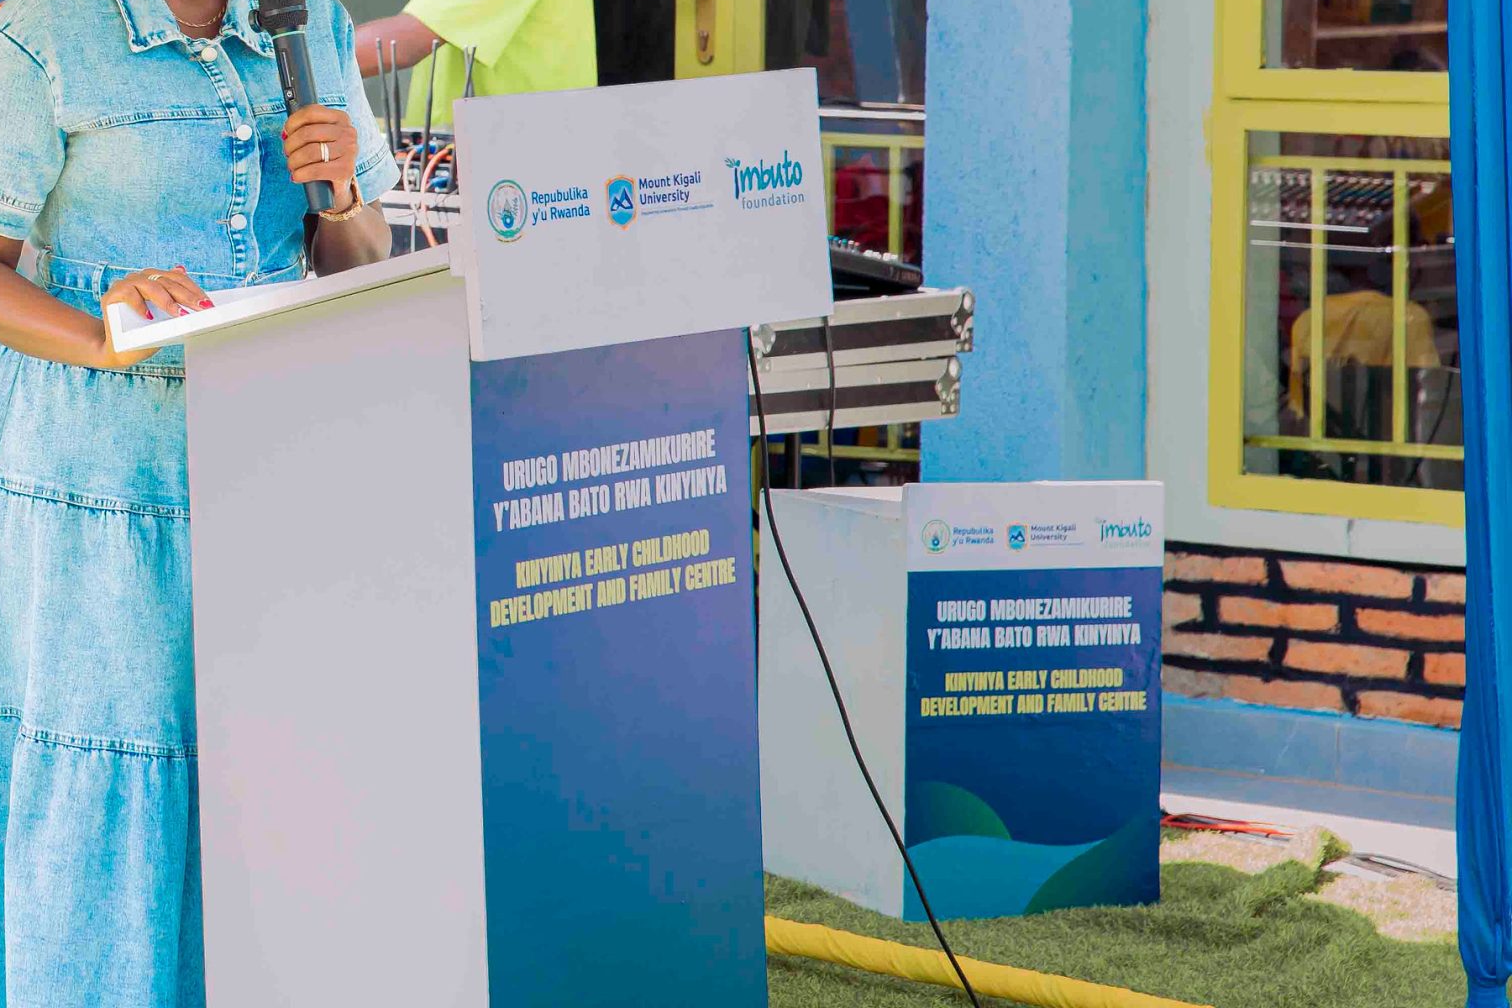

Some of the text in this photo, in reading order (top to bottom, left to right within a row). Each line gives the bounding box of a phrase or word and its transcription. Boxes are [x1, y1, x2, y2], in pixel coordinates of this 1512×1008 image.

[639, 171, 701, 190] Mount Kigali
[735, 150, 802, 200] imbuto
[532, 187, 588, 206] Repubulika
[640, 190, 689, 205] University
[742, 192, 804, 209] foundation
[532, 204, 590, 225] y'u Rwanda
[504, 428, 716, 492] URUGO MBONEZAMIKURIRE
[494, 465, 727, 532] Y'ABANA BATO RWA KINYINYA
[516, 528, 710, 588] KINYINYA EARLY CHILDHOOD
[490, 557, 736, 628] DEVELOPMENT AND FAMILY CENTRE
[937, 596, 1132, 622] URUGO MBONEZAMIKURIRE
[927, 623, 1141, 650] Y'ABANA BATO RWA KINYINYA
[945, 668, 1123, 692] KINYINYA EARLY CHILDHOOD
[921, 691, 1147, 717] DEVELOPMENT AND FAMILY CENTRE
